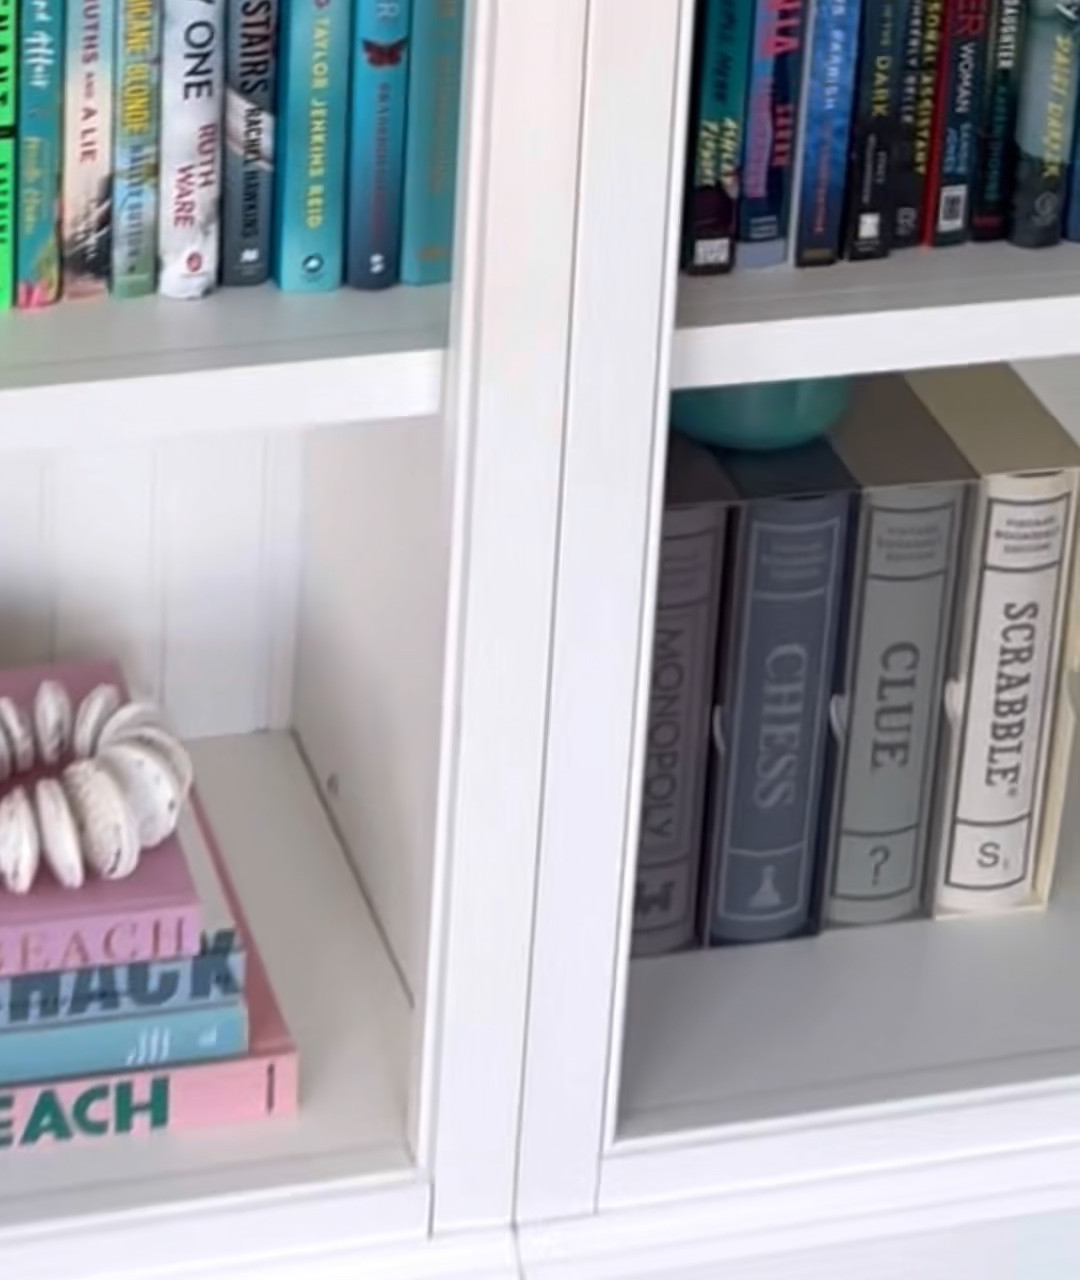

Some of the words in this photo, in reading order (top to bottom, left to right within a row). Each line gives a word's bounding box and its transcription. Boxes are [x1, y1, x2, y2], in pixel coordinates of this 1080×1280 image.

[181, 18, 218, 102] ONE
[310, 14, 331, 92] TAYLOR
[822, 27, 844, 112] PARRISH
[870, 53, 892, 118] DARK
[953, 41, 976, 114] WOMAN
[81, 104, 99, 122] A
[122, 62, 154, 136] BLONDE
[307, 95, 328, 179] JENKINS
[912, 72, 937, 175] ASSISTANT
[79, 125, 99, 164] LIE
[195, 122, 220, 190] RUTH
[172, 162, 197, 229] WARE
[306, 183, 326, 231] REID
[646, 628, 684, 838] MONOPOLY
[754, 642, 807, 810] CHESS
[870, 640, 920, 772] CLUE
